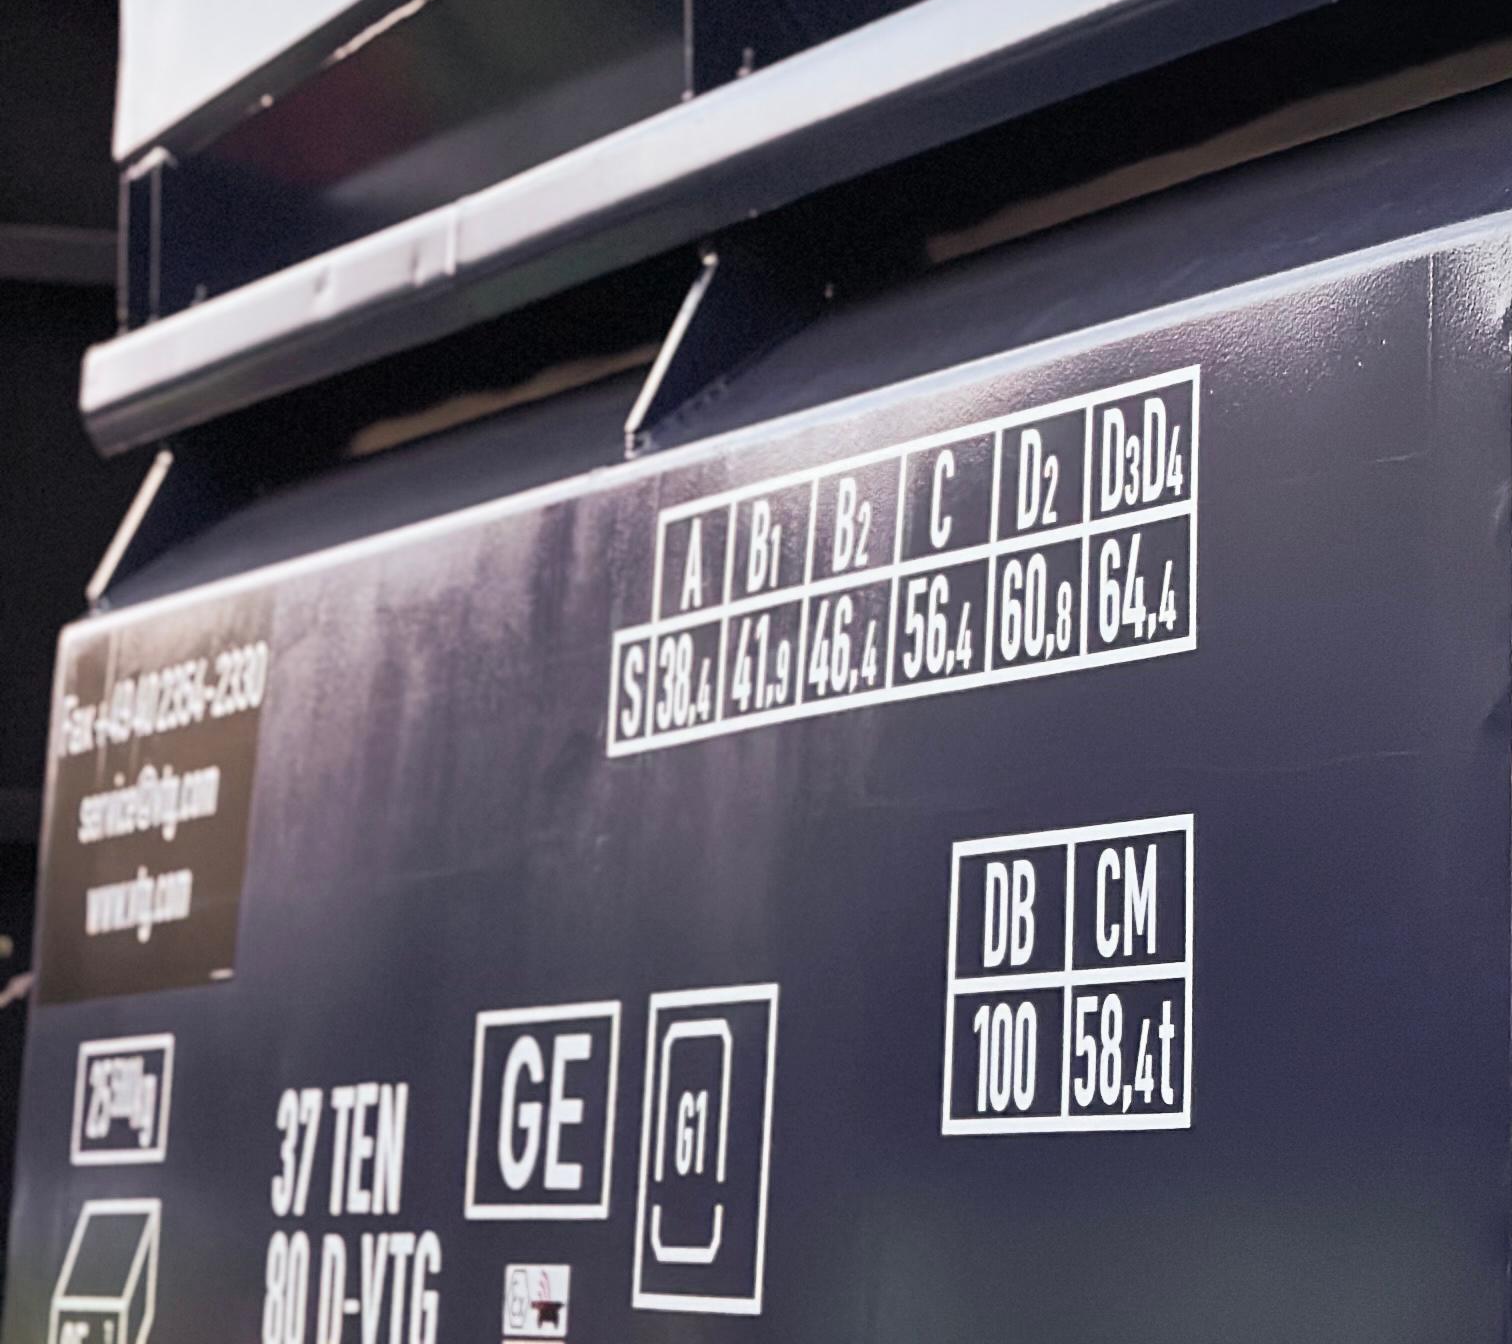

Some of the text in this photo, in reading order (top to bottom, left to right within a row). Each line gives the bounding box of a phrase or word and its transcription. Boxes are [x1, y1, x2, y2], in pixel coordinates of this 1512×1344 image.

[680, 518, 703, 611] A
[747, 502, 782, 592] B1
[832, 478, 871, 573] B2
[930, 450, 954, 549] C
[1017, 429, 1059, 531] D2
[622, 534, 1177, 737] S 38,4 41,9 46,4 56,4 60,8 64,4
[984, 844, 1157, 968] DB CM
[499, 1033, 592, 1191] GE
[973, 1001, 1037, 1112] 100
[271, 1088, 323, 1217] 37
[329, 1082, 409, 1216] TEN
[675, 1090, 708, 1176] G1
[262, 1229, 442, 1344] 80 D-VTG
